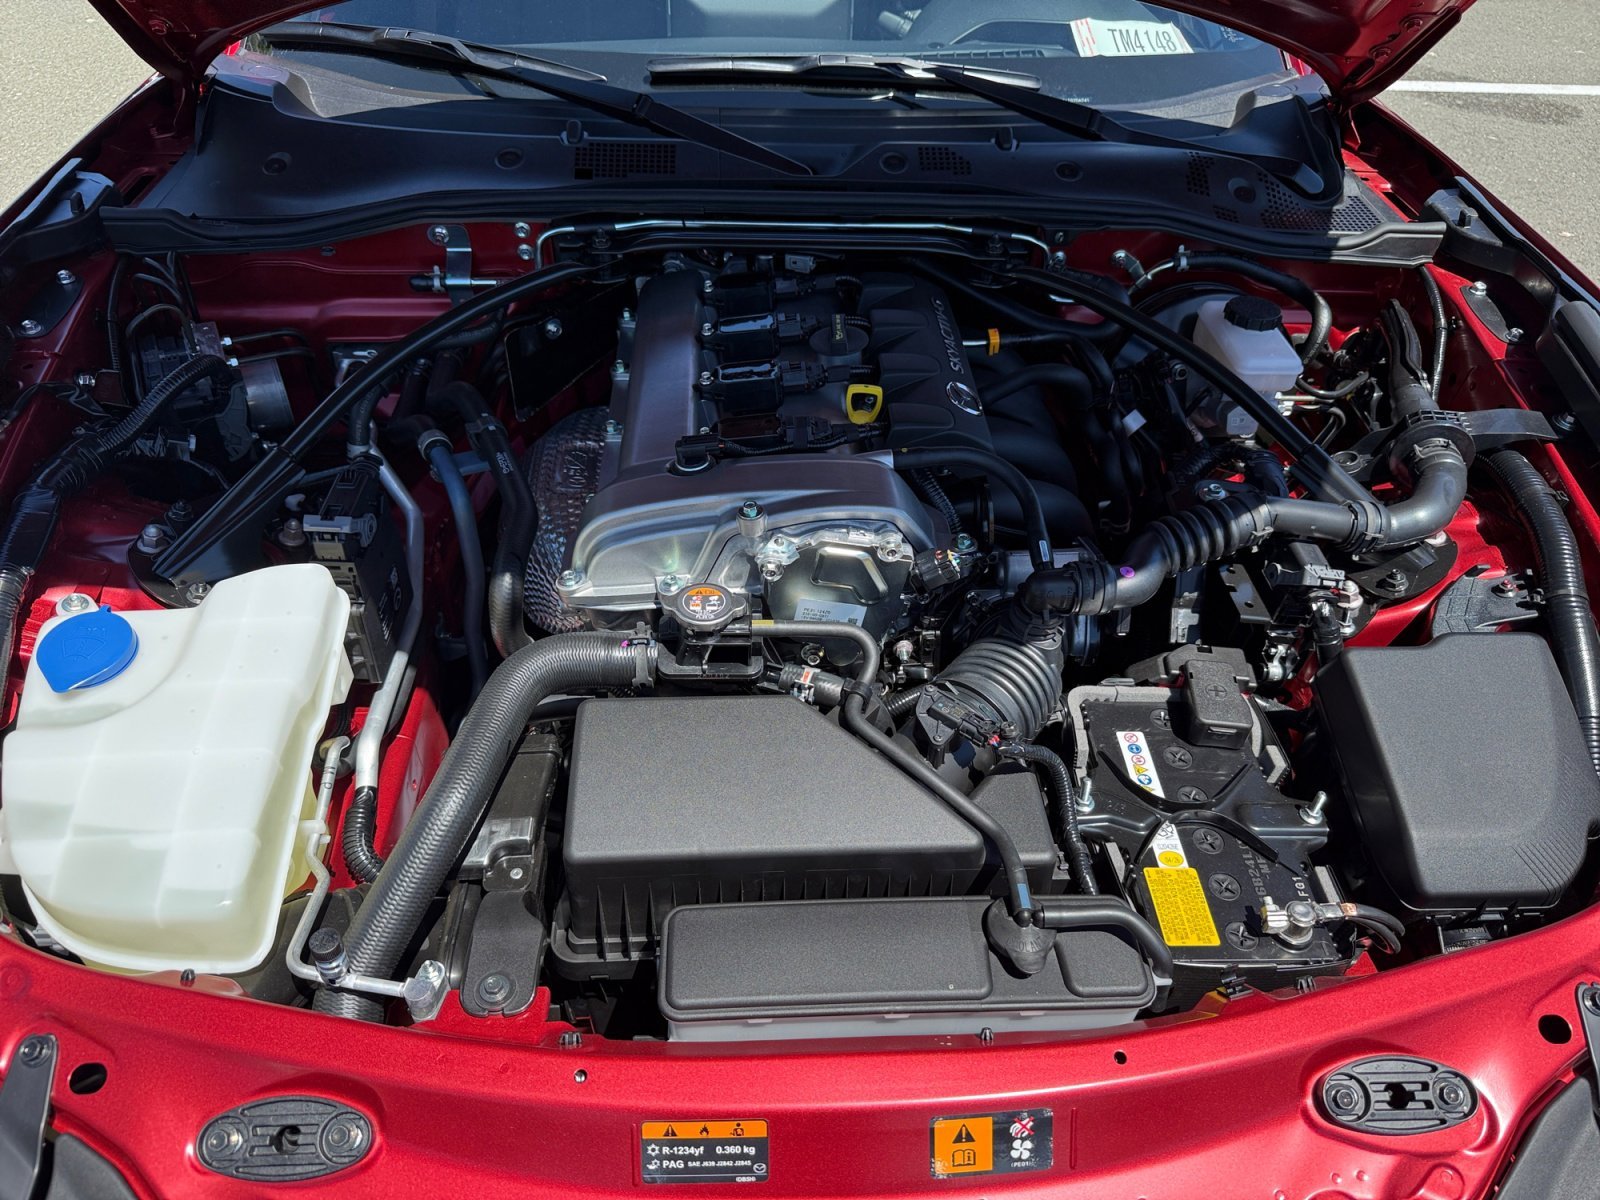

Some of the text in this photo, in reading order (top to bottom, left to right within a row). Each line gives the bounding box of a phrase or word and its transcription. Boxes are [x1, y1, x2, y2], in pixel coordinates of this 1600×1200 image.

[930, 296, 965, 375] SKYACTIV-G
[662, 1145, 756, 1156] R-1234yf 0.360 kg
[662, 1160, 685, 1169] PAG
